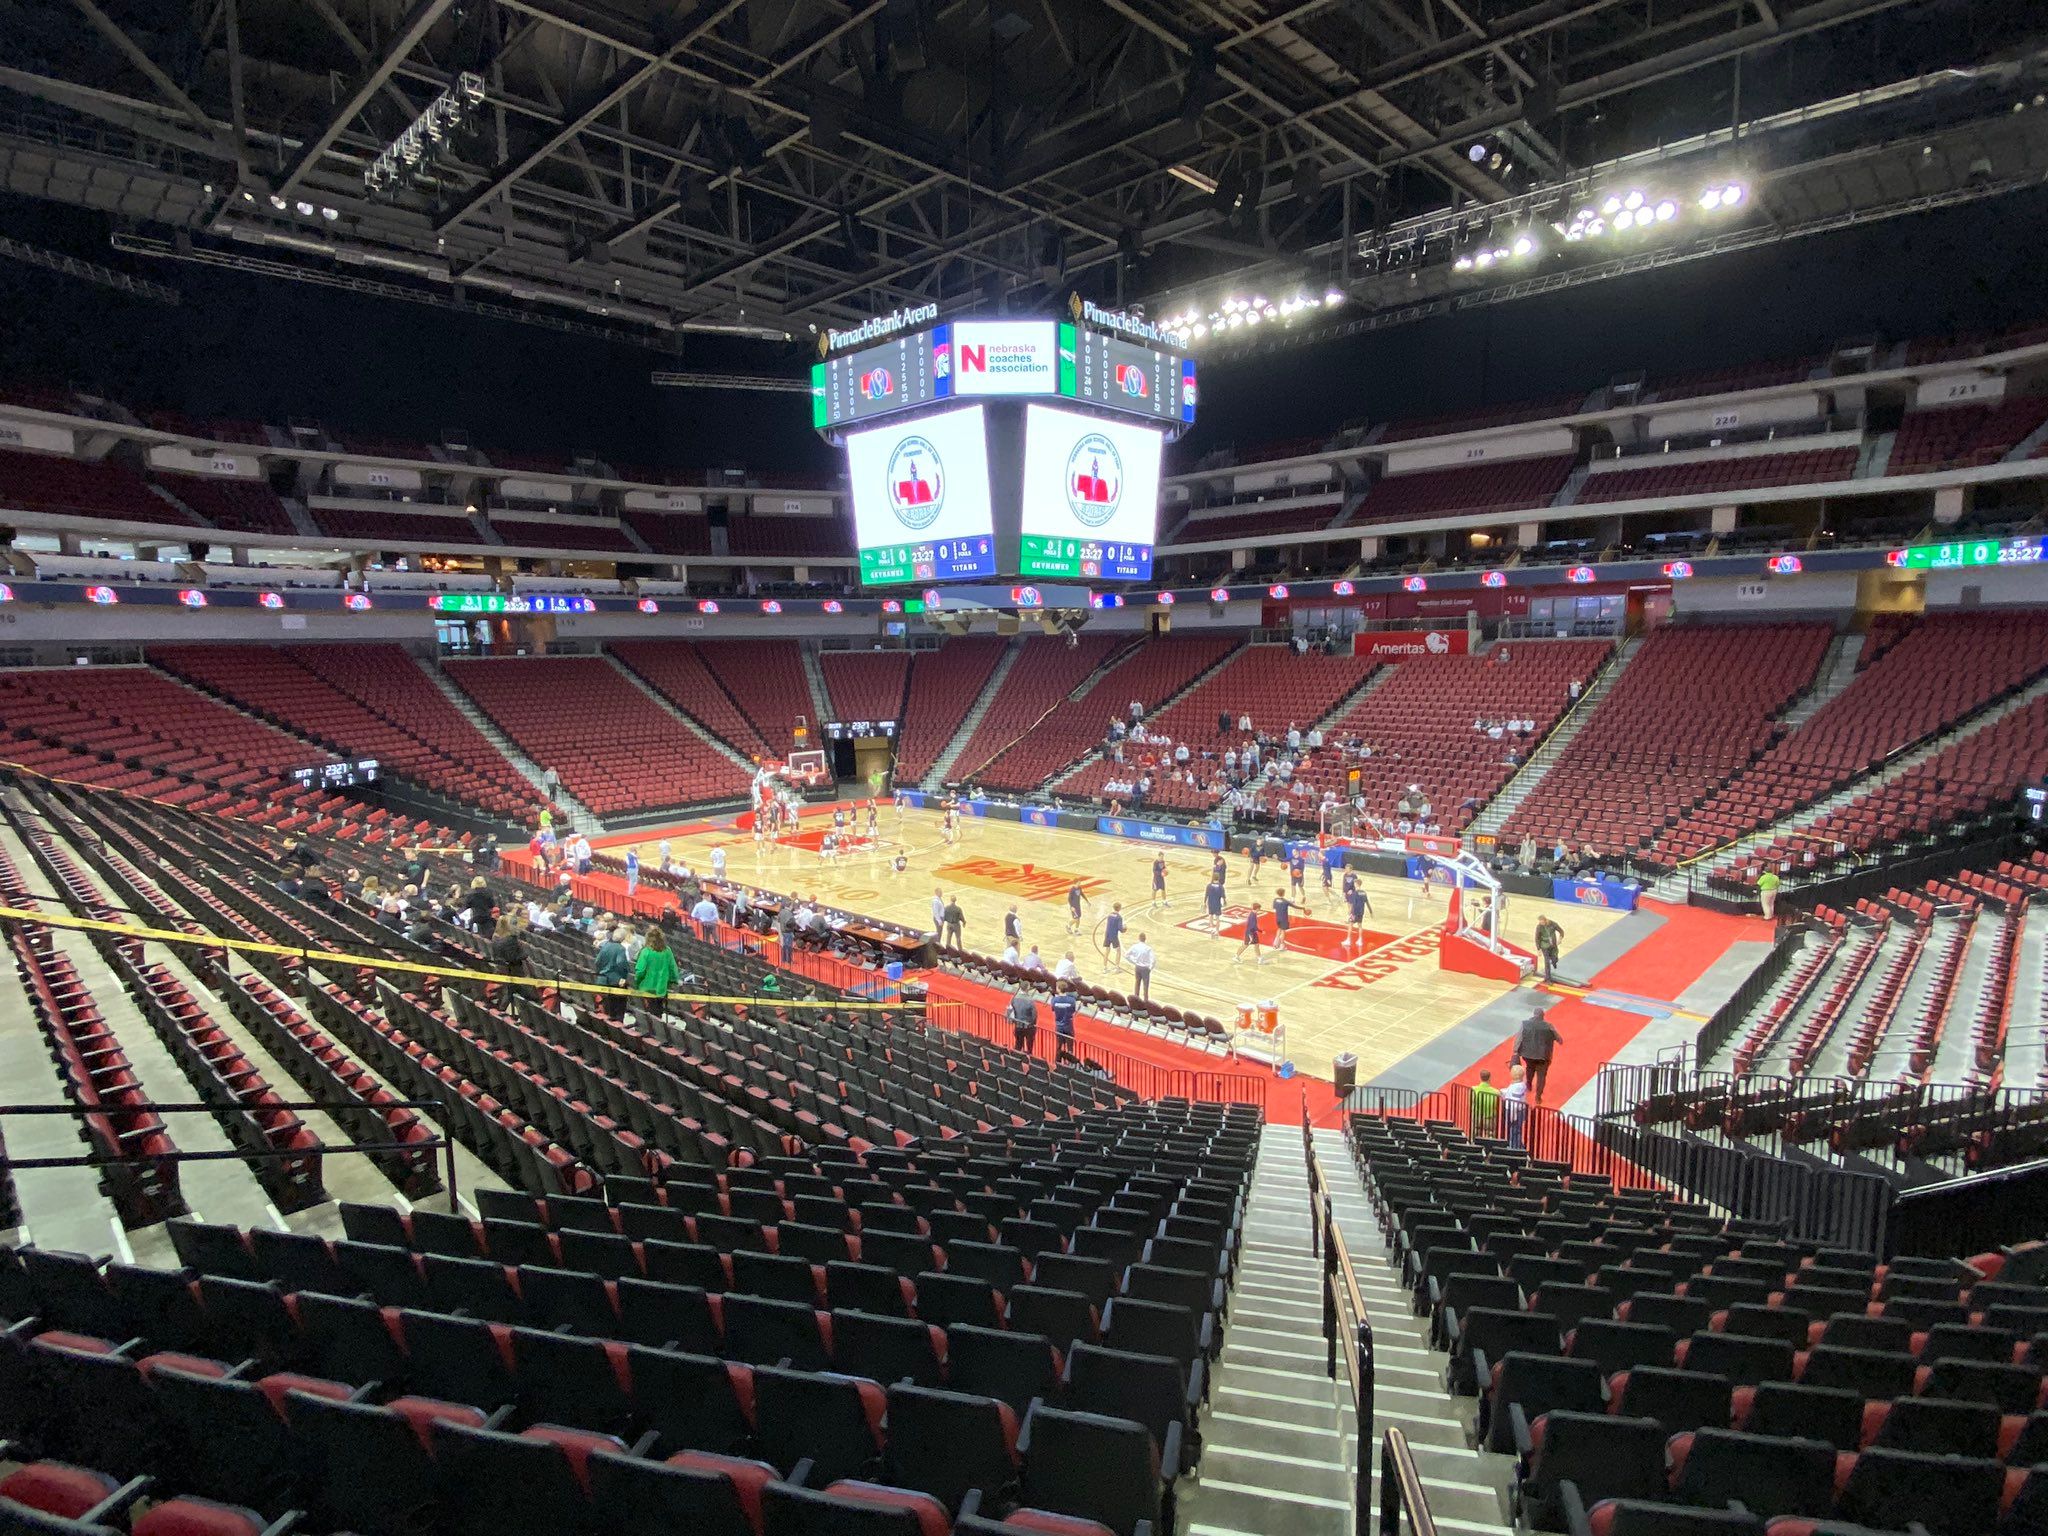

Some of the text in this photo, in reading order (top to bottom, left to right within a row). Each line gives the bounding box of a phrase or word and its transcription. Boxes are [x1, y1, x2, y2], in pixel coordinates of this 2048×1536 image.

[902, 303, 938, 327] Arena
[1159, 331, 1188, 349] Arena
[989, 344, 1036, 353] nebraska
[960, 344, 986, 373] N
[989, 354, 1032, 363] coaches
[989, 363, 1048, 373] association
[1715, 416, 1737, 426] 220
[1467, 448, 1484, 458] 219
[213, 462, 234, 470] 210
[912, 550, 934, 563] 23:27
[940, 544, 948, 559] 0
[961, 542, 967, 551] 0
[1048, 540, 1054, 550] 0
[1066, 543, 1074, 558] 0
[1080, 548, 1102, 560] 23:27
[1108, 546, 1116, 560] 0
[1126, 547, 1132, 556] 0
[1940, 544, 1988, 563] 0 0
[1998, 547, 2043, 562] 23:27
[898, 549, 906, 564] 0
[952, 563, 978, 572] TITANS
[1032, 562, 1070, 571] SKYHAWKS
[1116, 566, 1138, 575] TITANS
[1740, 586, 1764, 595] 119
[466, 596, 498, 610] 0 0
[504, 598, 565, 612] 23:27 0 0
[1366, 602, 1380, 610] 117
[1371, 642, 1425, 654] Ameritas
[834, 730, 840, 738] 0
[887, 728, 892, 736] 0
[368, 770, 374, 781] 0
[2032, 804, 2040, 819] 0
[1140, 831, 1176, 842] CHAMPIONSHIPS
